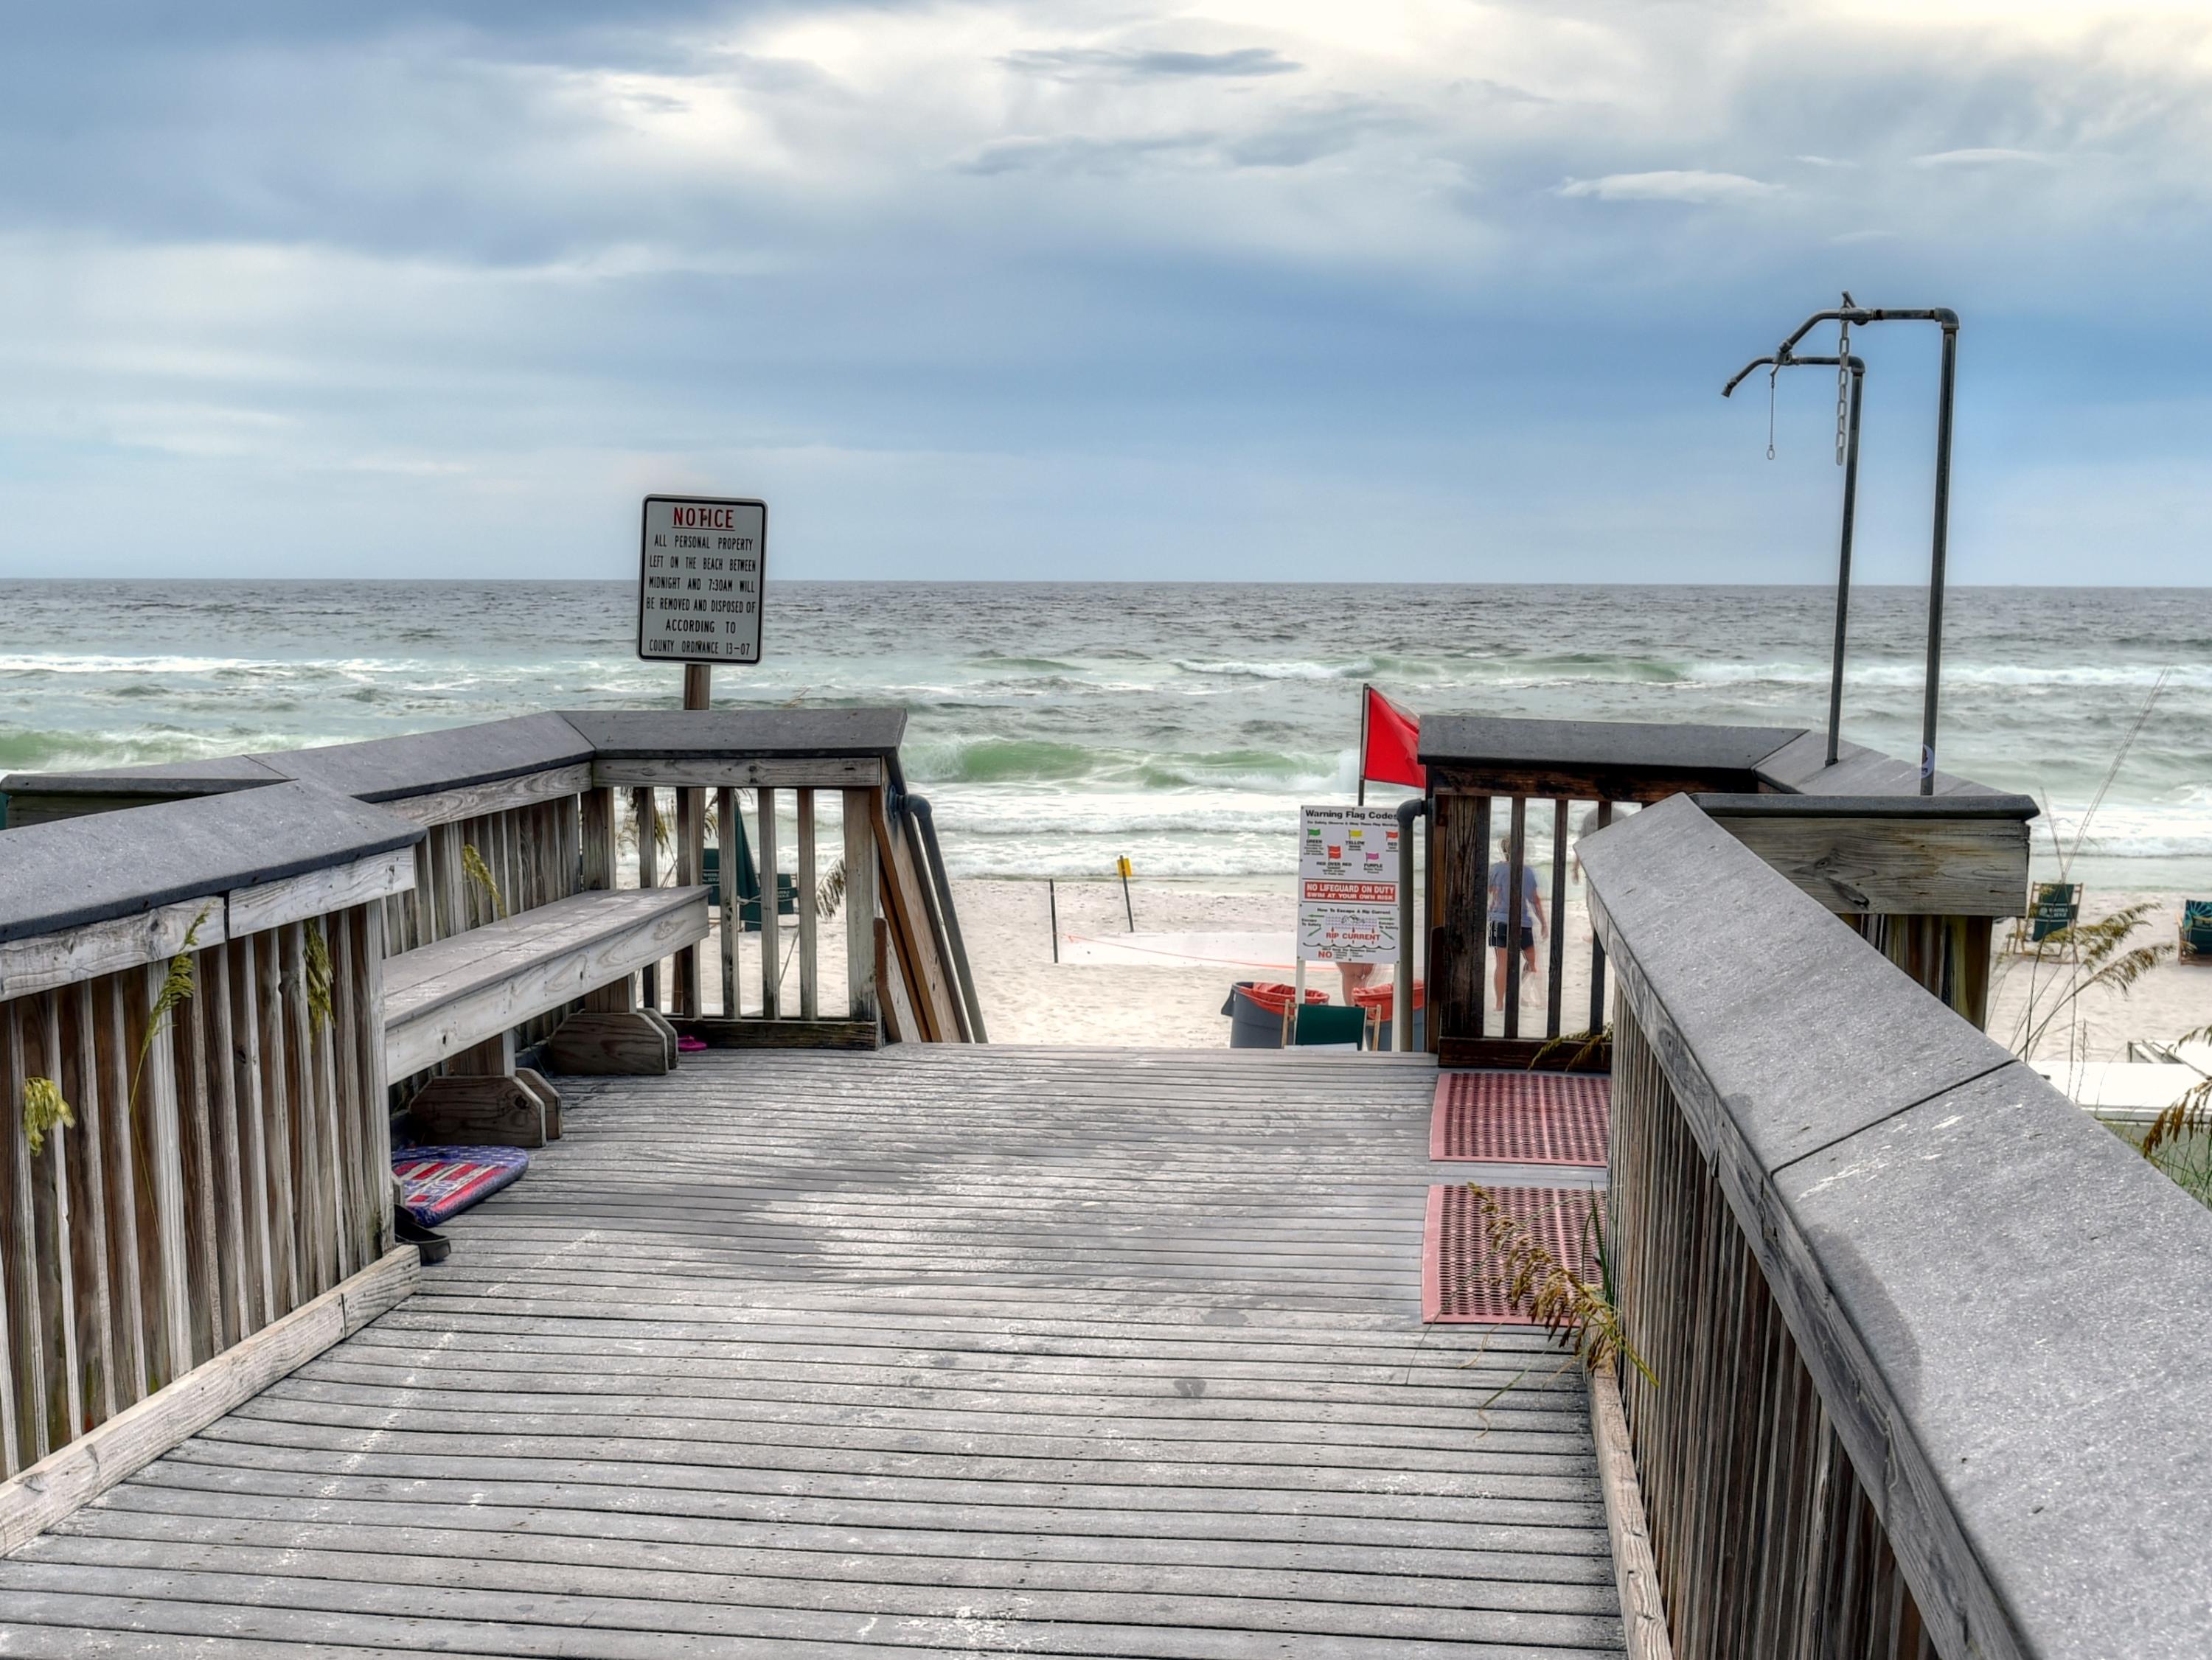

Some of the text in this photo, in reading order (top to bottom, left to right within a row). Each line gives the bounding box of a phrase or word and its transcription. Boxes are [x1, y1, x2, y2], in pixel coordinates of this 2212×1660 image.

[674, 507, 734, 528] NOTICE
[655, 534, 753, 551] ALL PERSONAL PROPERTY
[650, 555, 756, 572] LEFT ON THE BEACH BETWEEN
[649, 576, 754, 593] MIDNIGHT AND 7:30AM WILL
[647, 597, 756, 613] BE REMOVED AND DISPOSED OF
[666, 619, 736, 633] ACCORDING TO
[650, 639, 750, 655] COUNTY ORDINANCE 13-07
[1306, 809, 1343, 819] Warning
[1346, 811, 1366, 820] Flag
[1320, 885, 1359, 893] LIFEGUARD
